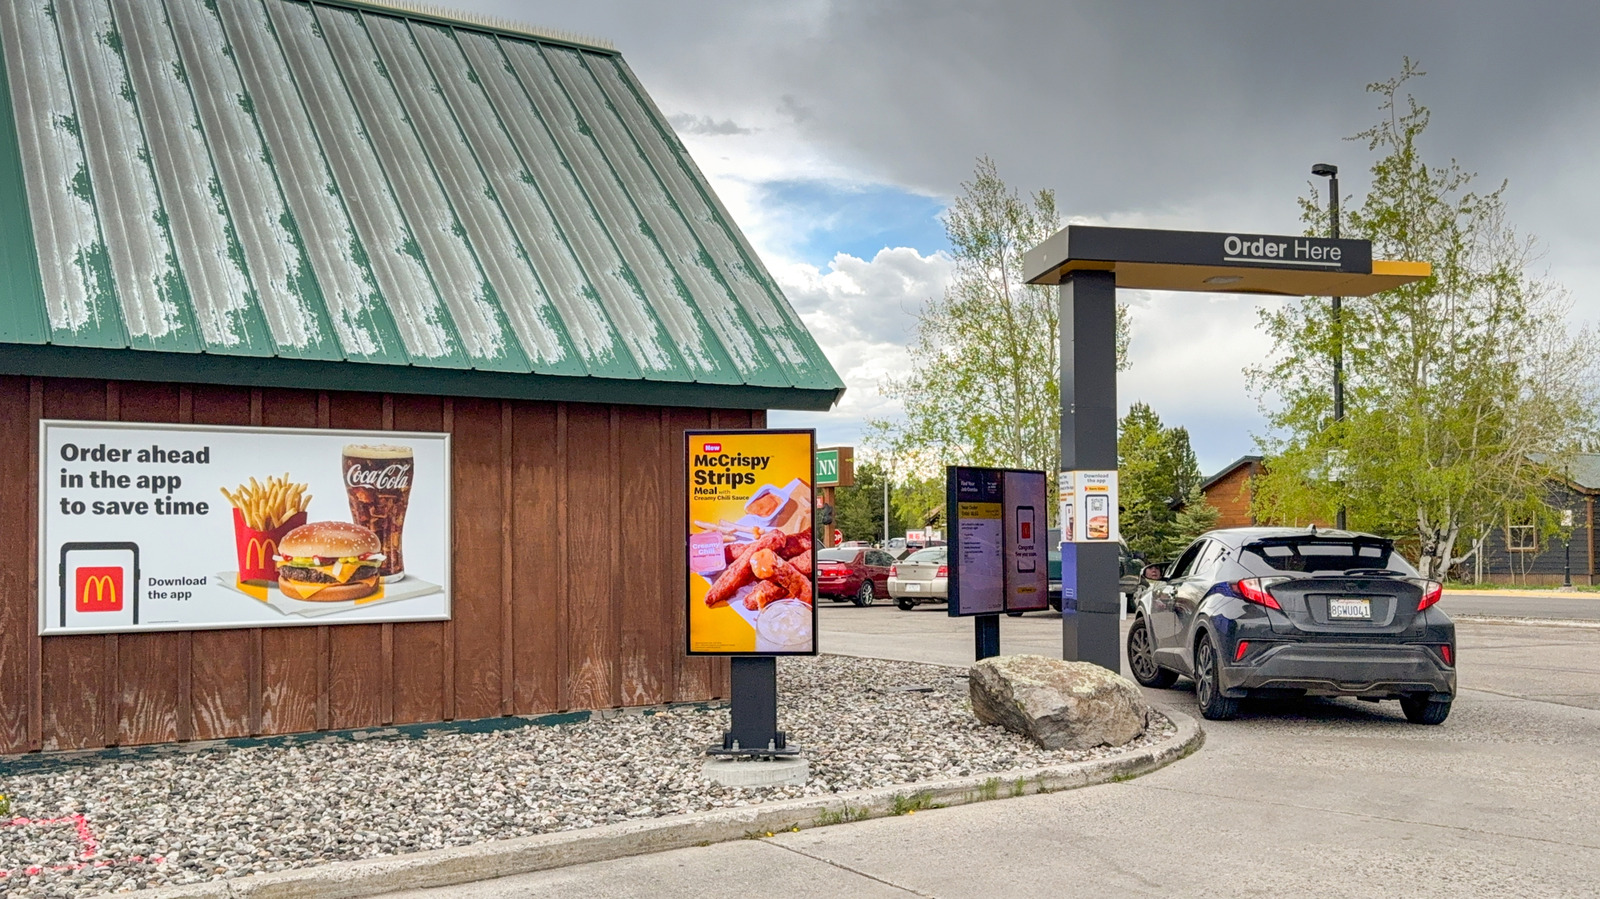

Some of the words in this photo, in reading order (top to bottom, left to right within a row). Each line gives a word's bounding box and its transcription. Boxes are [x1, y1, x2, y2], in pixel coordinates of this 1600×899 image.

[1224, 236, 1287, 258] Order
[1294, 239, 1342, 261] Here
[60, 443, 132, 462] Order
[136, 445, 210, 464] ahead
[60, 467, 83, 488] in
[89, 470, 131, 489] the
[136, 475, 182, 494] app
[346, 463, 410, 490] Coca-Cola
[694, 467, 756, 490] Strips
[694, 486, 717, 495] Meal
[59, 497, 86, 515] to
[92, 501, 149, 515] save
[154, 495, 210, 515] time
[148, 576, 207, 587] Download
[148, 590, 167, 600] the
[170, 590, 192, 601] app
[1331, 605, 1370, 617] 8GWU041
